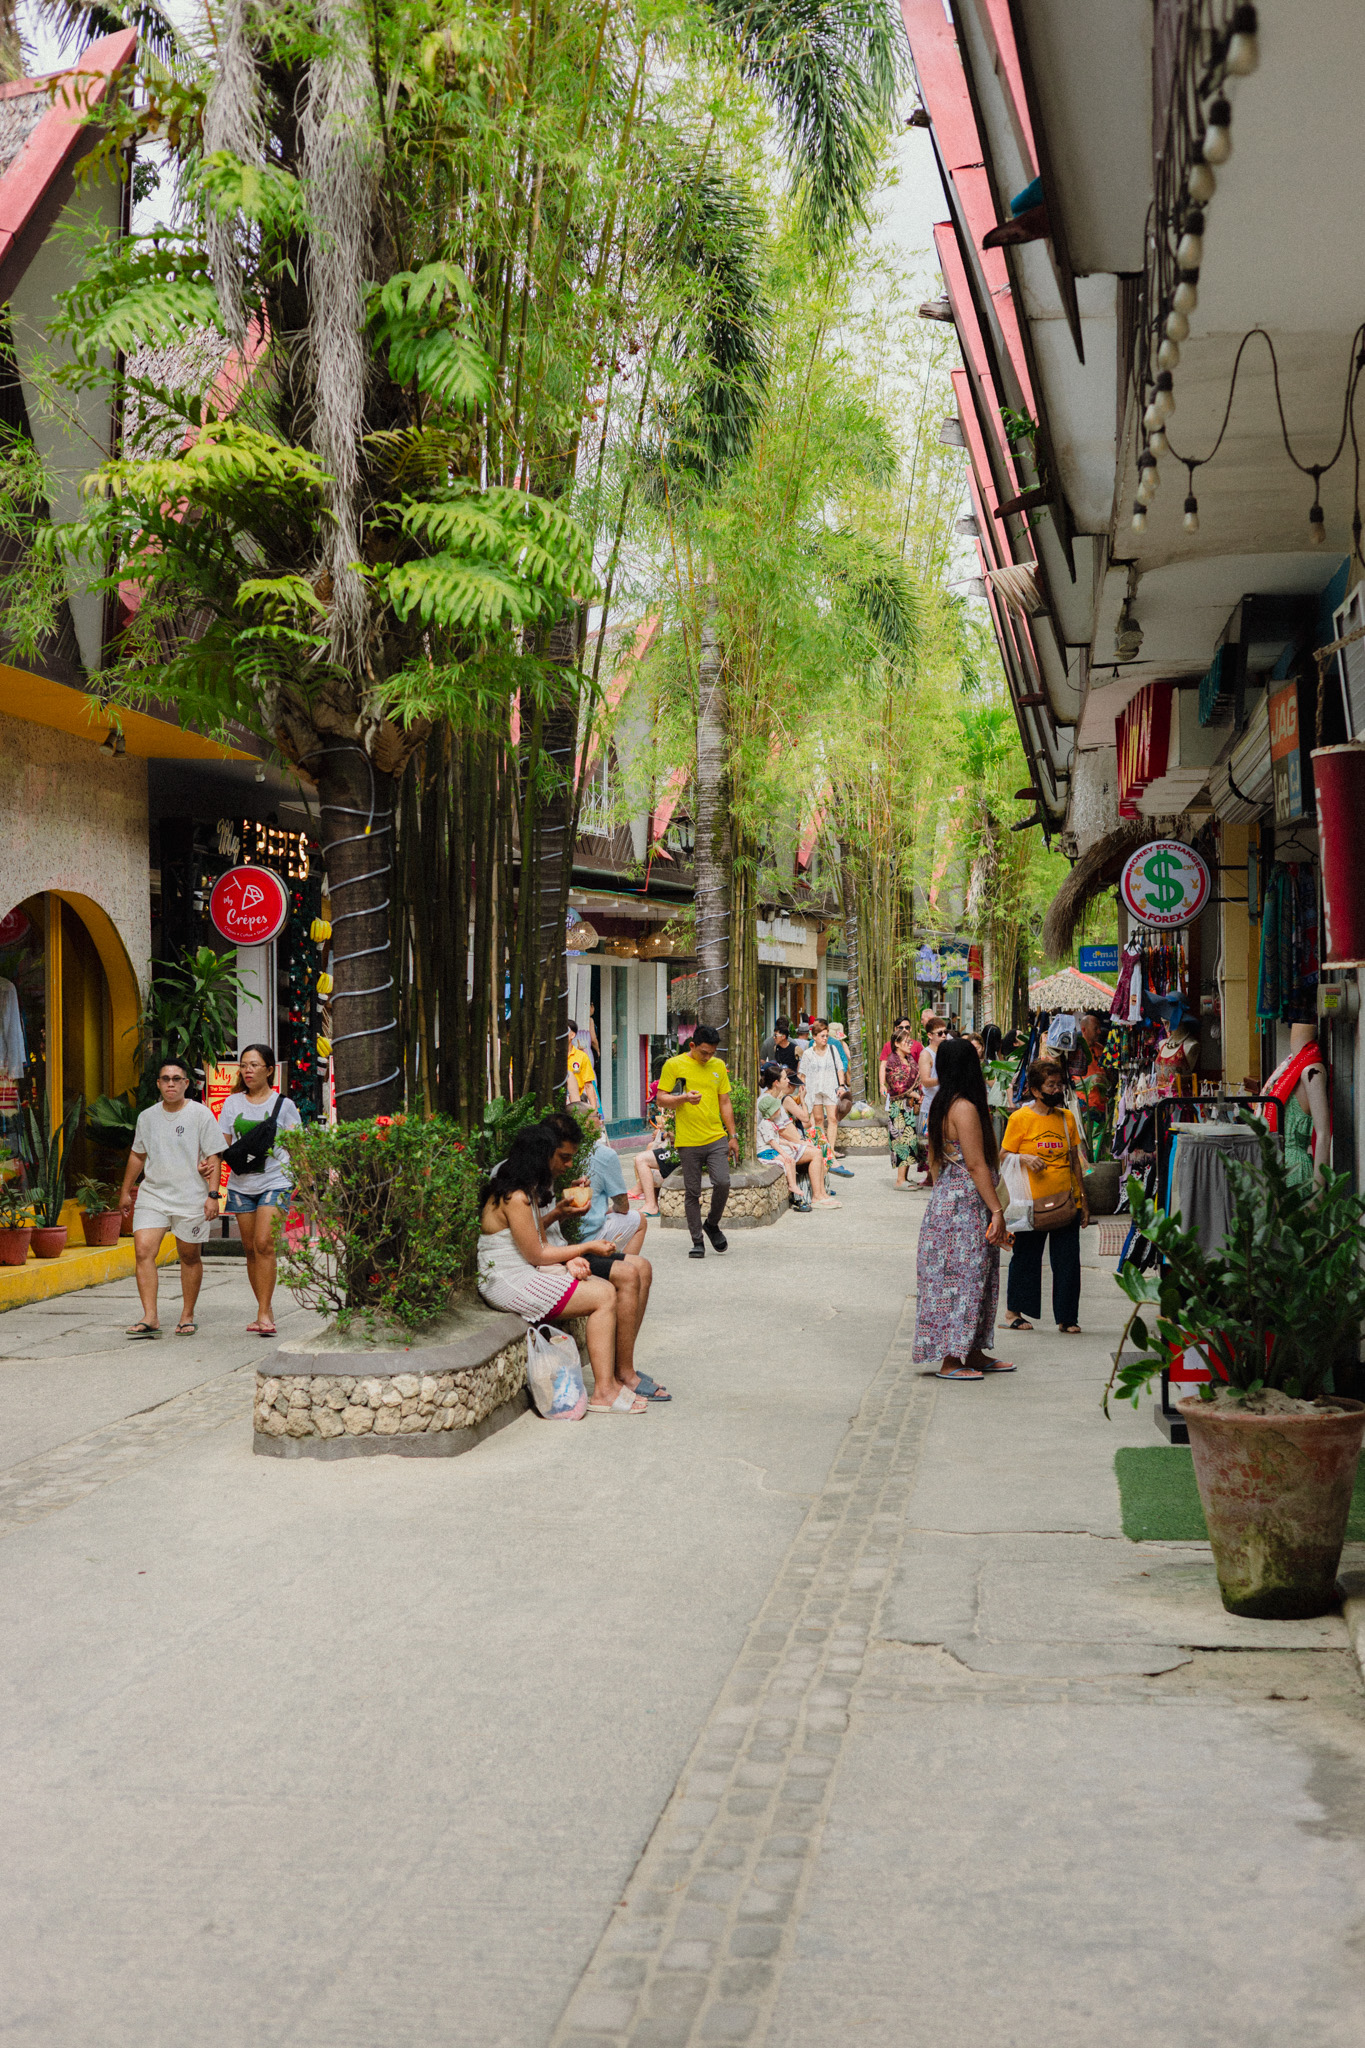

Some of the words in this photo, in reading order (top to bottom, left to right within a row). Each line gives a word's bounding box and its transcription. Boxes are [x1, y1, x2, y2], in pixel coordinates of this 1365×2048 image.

[1271, 695, 1297, 747] JAG
[1127, 846, 1153, 873] MONEY
[1156, 843, 1202, 869] EXCHANGE
[224, 895, 234, 906] My
[1147, 912, 1184, 923] FOREX
[214, 1067, 232, 1085] My
